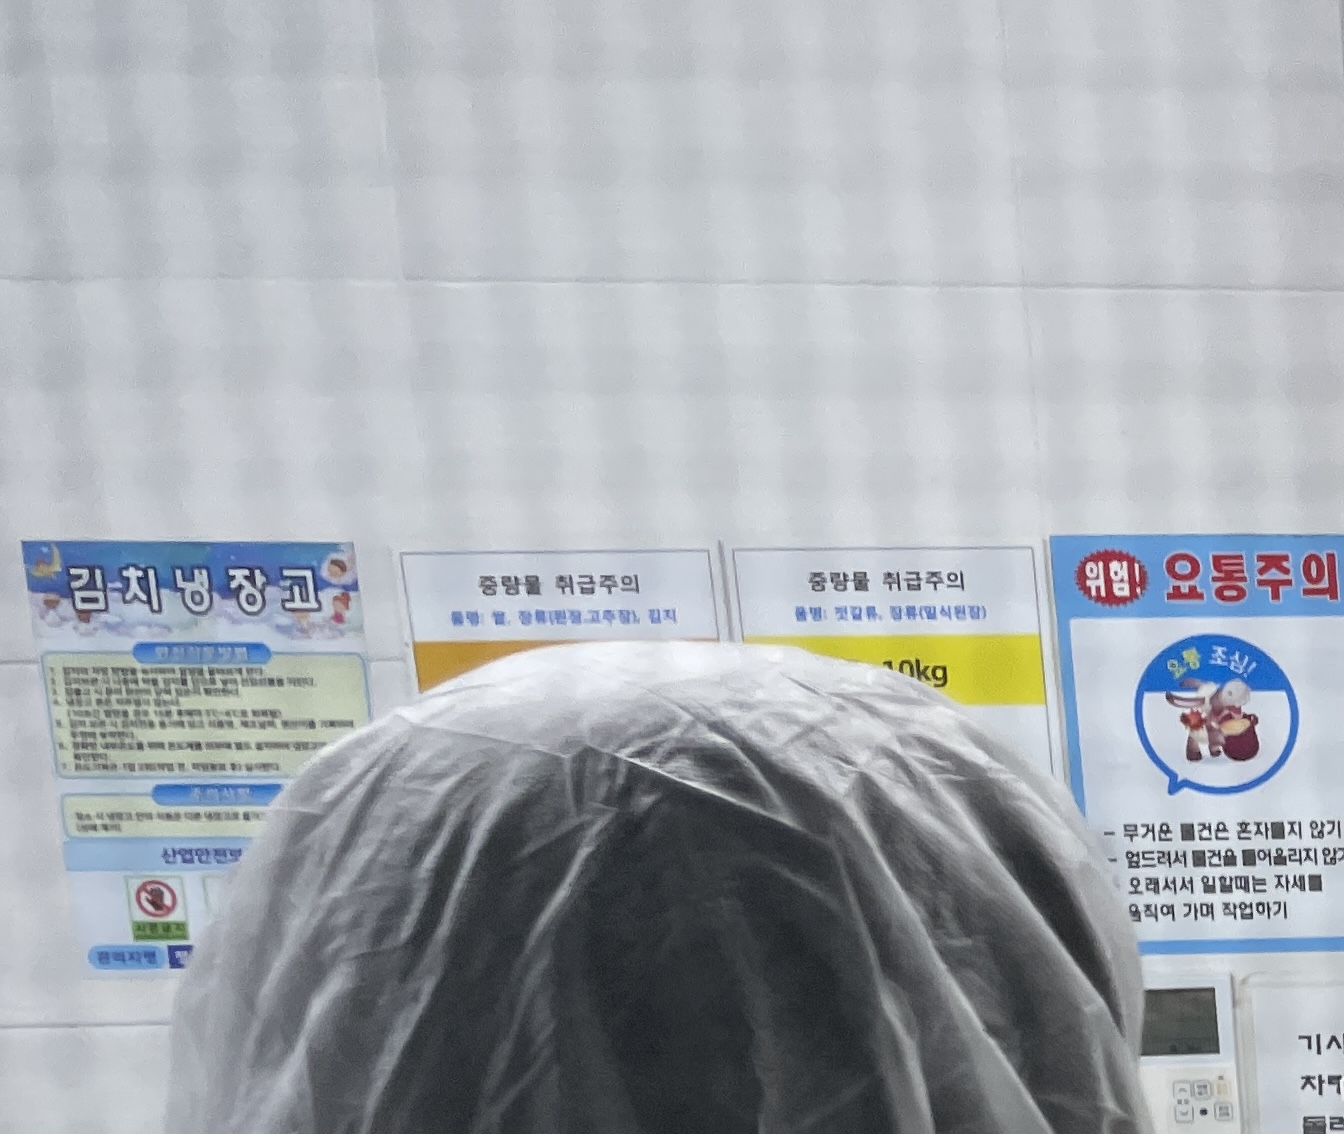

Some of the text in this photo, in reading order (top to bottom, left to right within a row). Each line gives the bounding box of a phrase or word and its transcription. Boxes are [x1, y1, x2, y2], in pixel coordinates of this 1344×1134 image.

[68, 566, 321, 614] 김치냉장고
[479, 573, 640, 596] 중량물 취급주의
[808, 570, 966, 592] 중량물 취급주의
[1085, 553, 1340, 604] 위험! 요통주의
[1209, 645, 1257, 678] 조심!
[1123, 822, 1173, 843] 무거운
[1309, 819, 1342, 840] 않기
[1128, 875, 1195, 896] 오래서서
[1183, 902, 1215, 921] 가며
